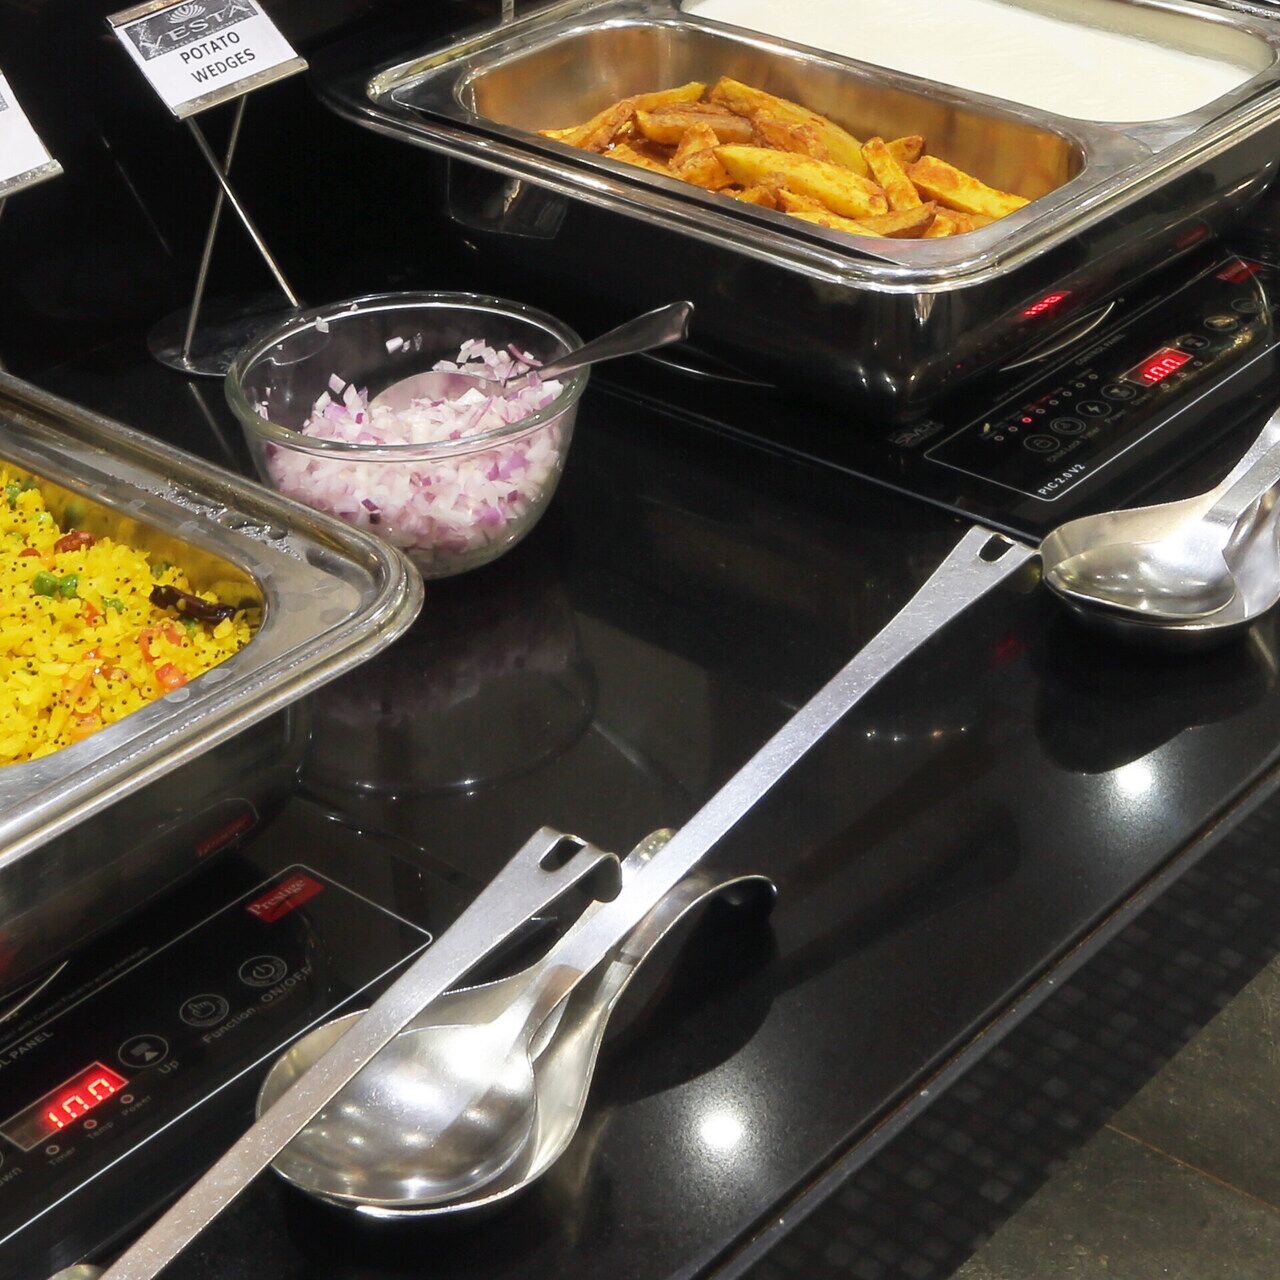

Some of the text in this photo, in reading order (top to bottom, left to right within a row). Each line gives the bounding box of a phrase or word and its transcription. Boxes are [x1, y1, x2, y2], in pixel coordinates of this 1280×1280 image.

[140, 4, 251, 50] VESTA
[179, 31, 241, 64] POTATO
[191, 48, 256, 83] WEDGES
[1142, 357, 1183, 382] 100
[1037, 463, 1086, 495] PIC 2.0 V2
[246, 879, 305, 917] Prestige
[261, 964, 312, 1003] ON/OFF
[201, 1007, 257, 1045] Function
[8, 1030, 54, 1062] PANEL
[157, 1059, 181, 1076] Up
[46, 1076, 118, 1129] 100
[121, 1095, 153, 1117] Power
[87, 1120, 115, 1141] Temp
[47, 1146, 76, 1167] Timer
